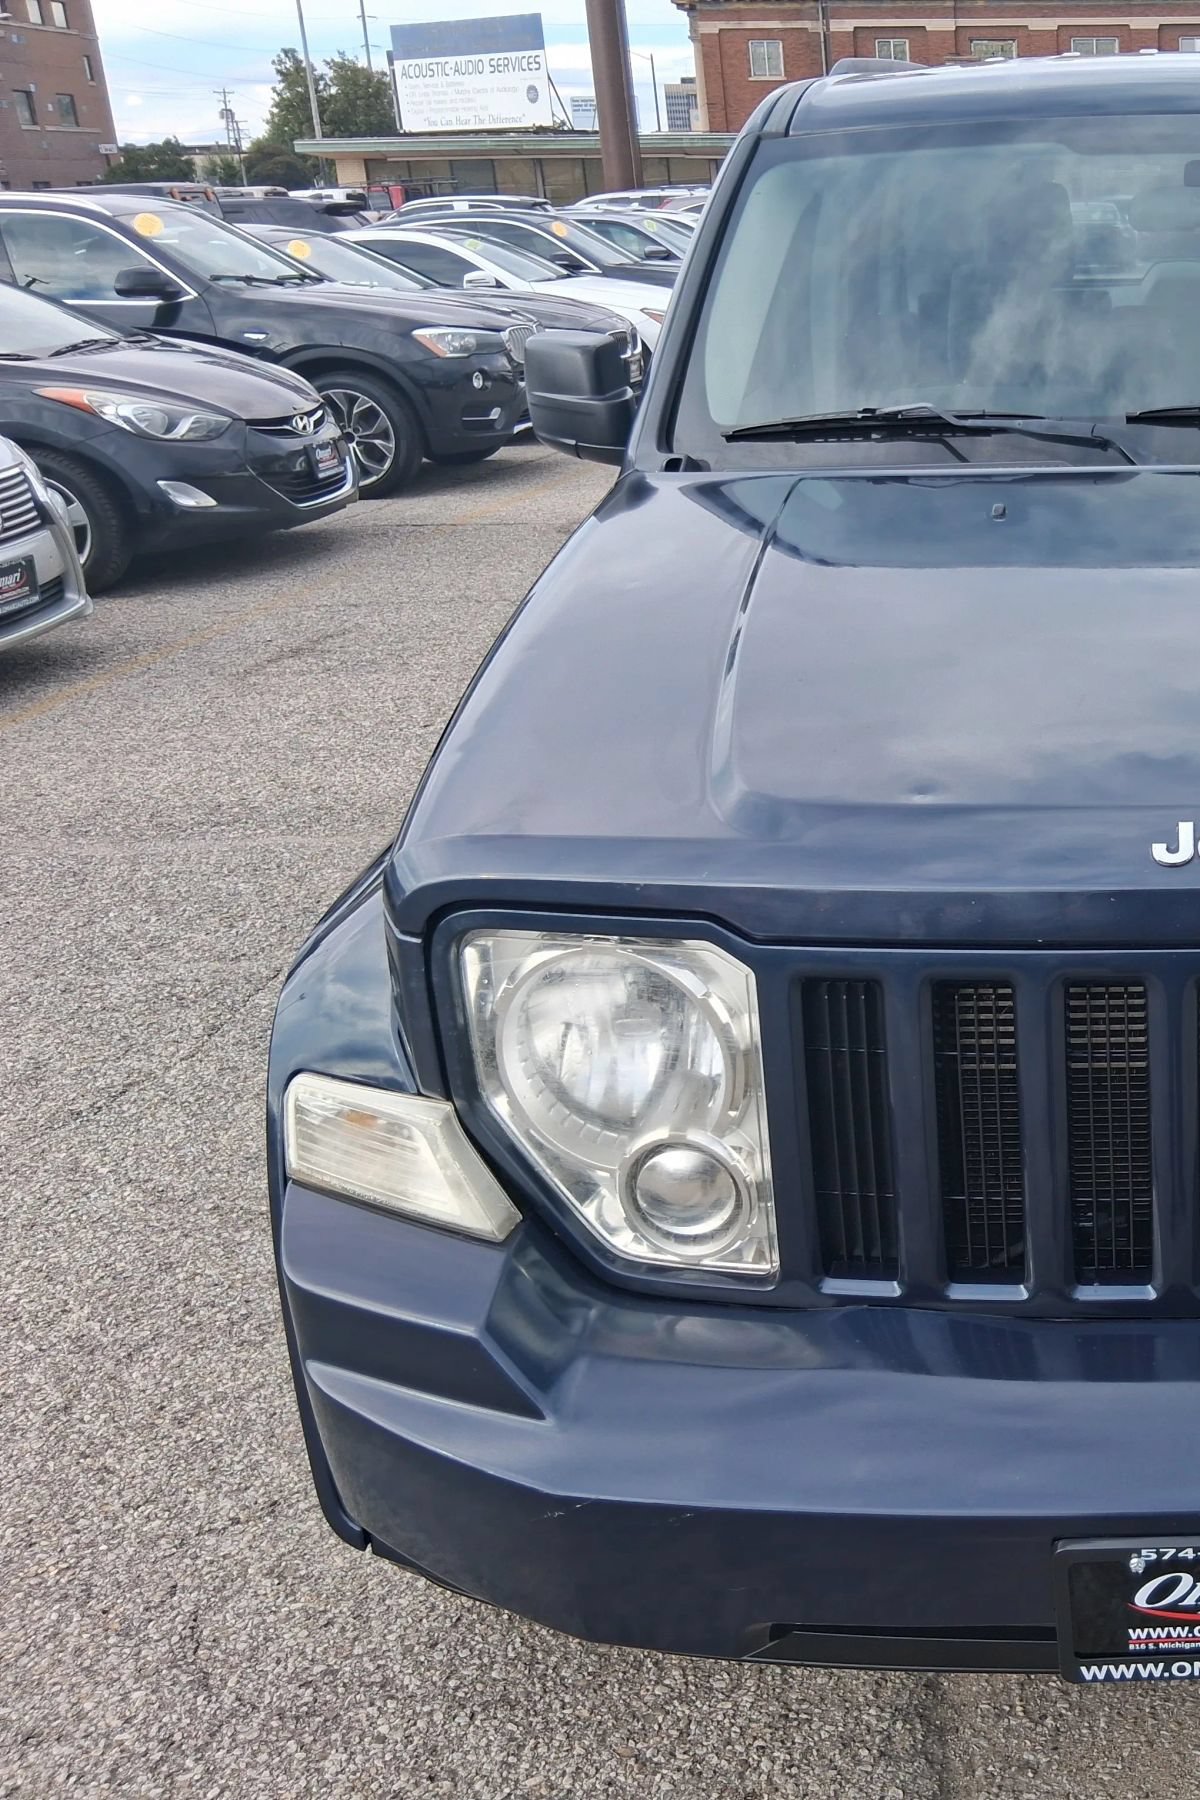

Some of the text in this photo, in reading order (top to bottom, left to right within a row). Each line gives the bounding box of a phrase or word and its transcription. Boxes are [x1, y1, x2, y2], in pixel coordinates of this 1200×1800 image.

[488, 54, 542, 74] SERVICES
[440, 116, 452, 127] Can
[455, 114, 471, 126] Hear
[474, 113, 487, 125] The
